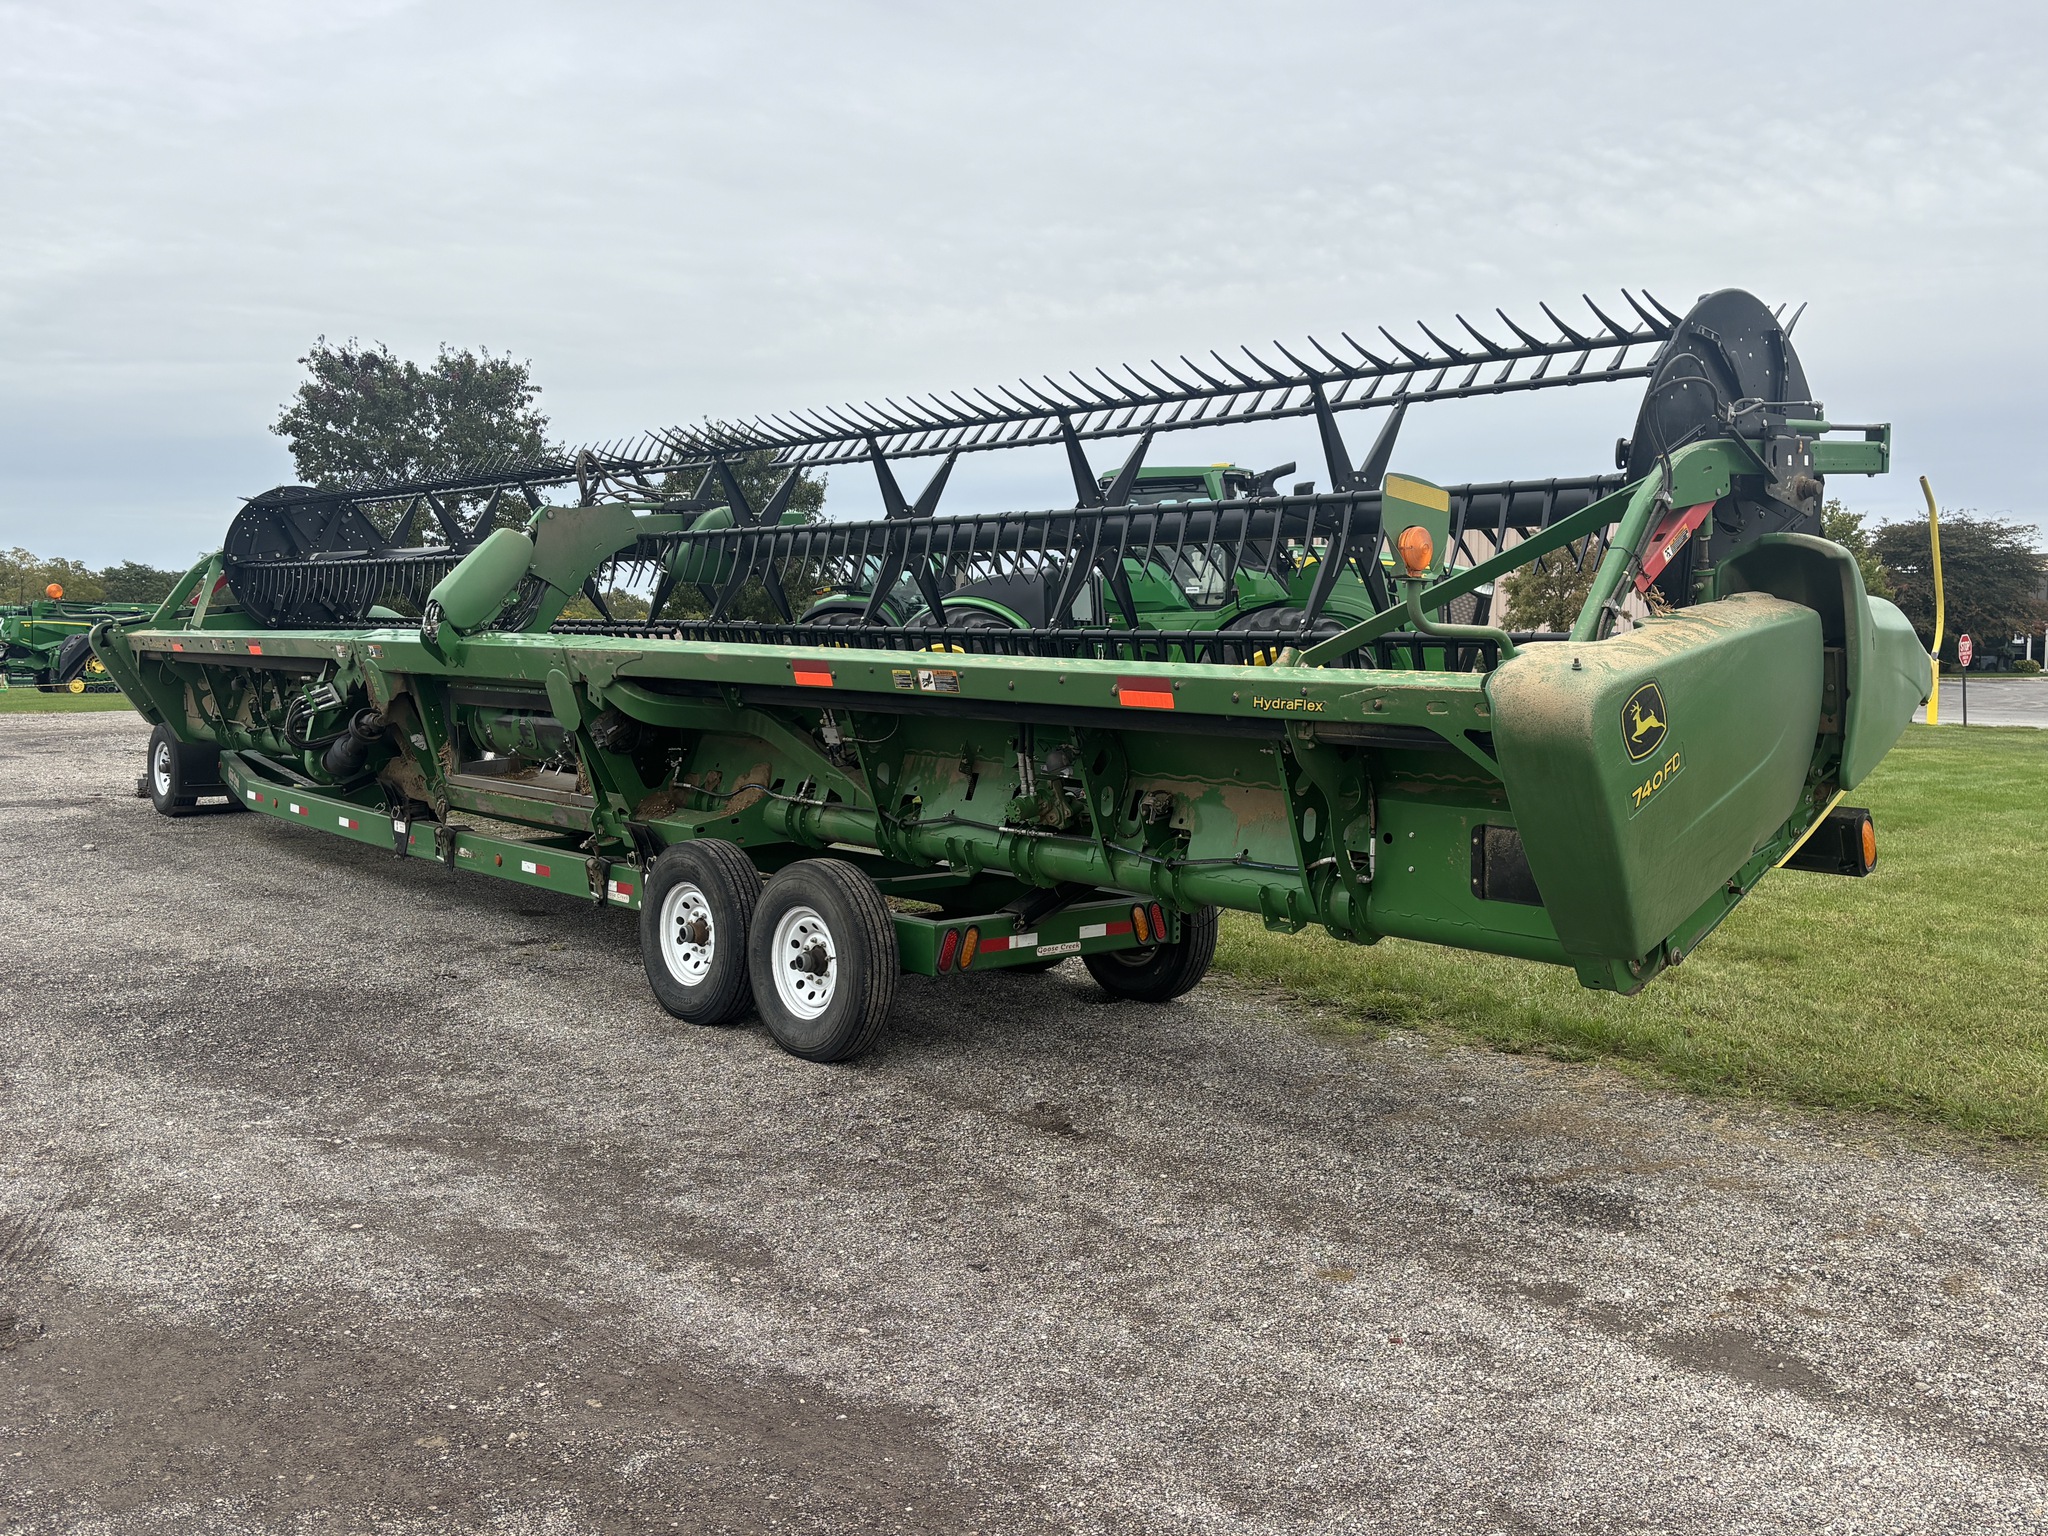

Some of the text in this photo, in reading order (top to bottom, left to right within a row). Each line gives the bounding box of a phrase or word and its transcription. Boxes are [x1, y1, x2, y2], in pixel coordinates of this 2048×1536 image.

[1960, 641, 1970, 652] STOP
[1253, 696, 1324, 712] HydraFlex
[1631, 752, 1681, 809] 740FD
[1037, 946, 1058, 954] Goose
